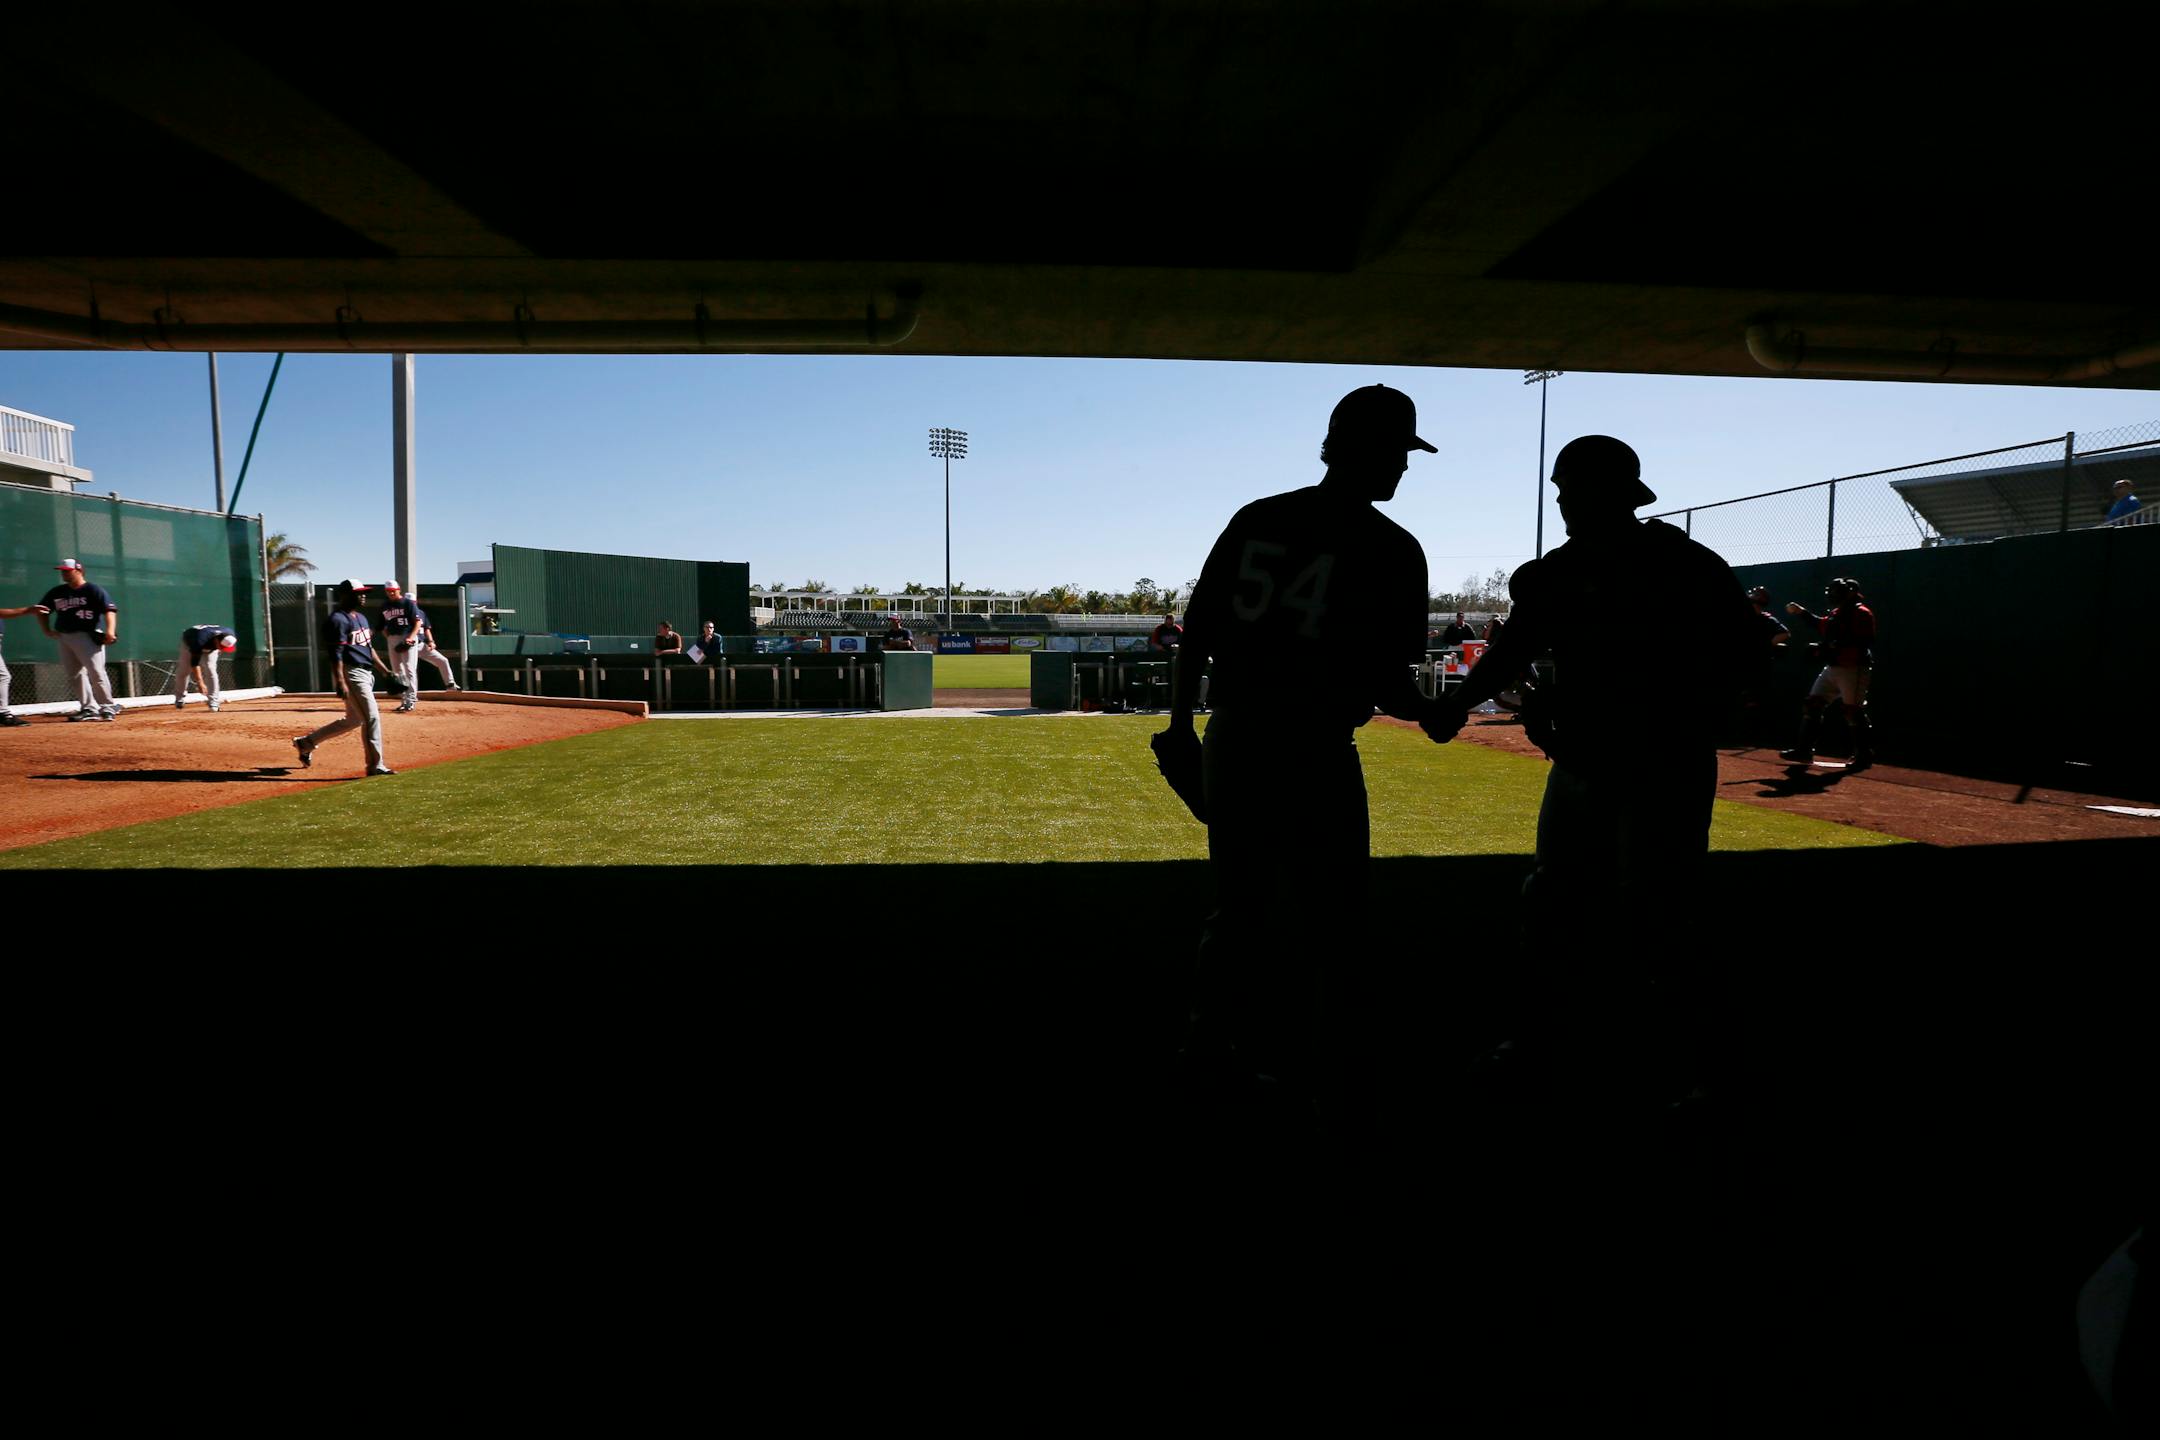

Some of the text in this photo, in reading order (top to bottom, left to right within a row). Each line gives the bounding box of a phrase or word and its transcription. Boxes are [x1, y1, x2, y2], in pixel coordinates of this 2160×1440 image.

[1232, 538, 1336, 638] 54
[75, 610, 94, 619] 45
[397, 618, 408, 626] 51
[1474, 647, 1482, 656] G
